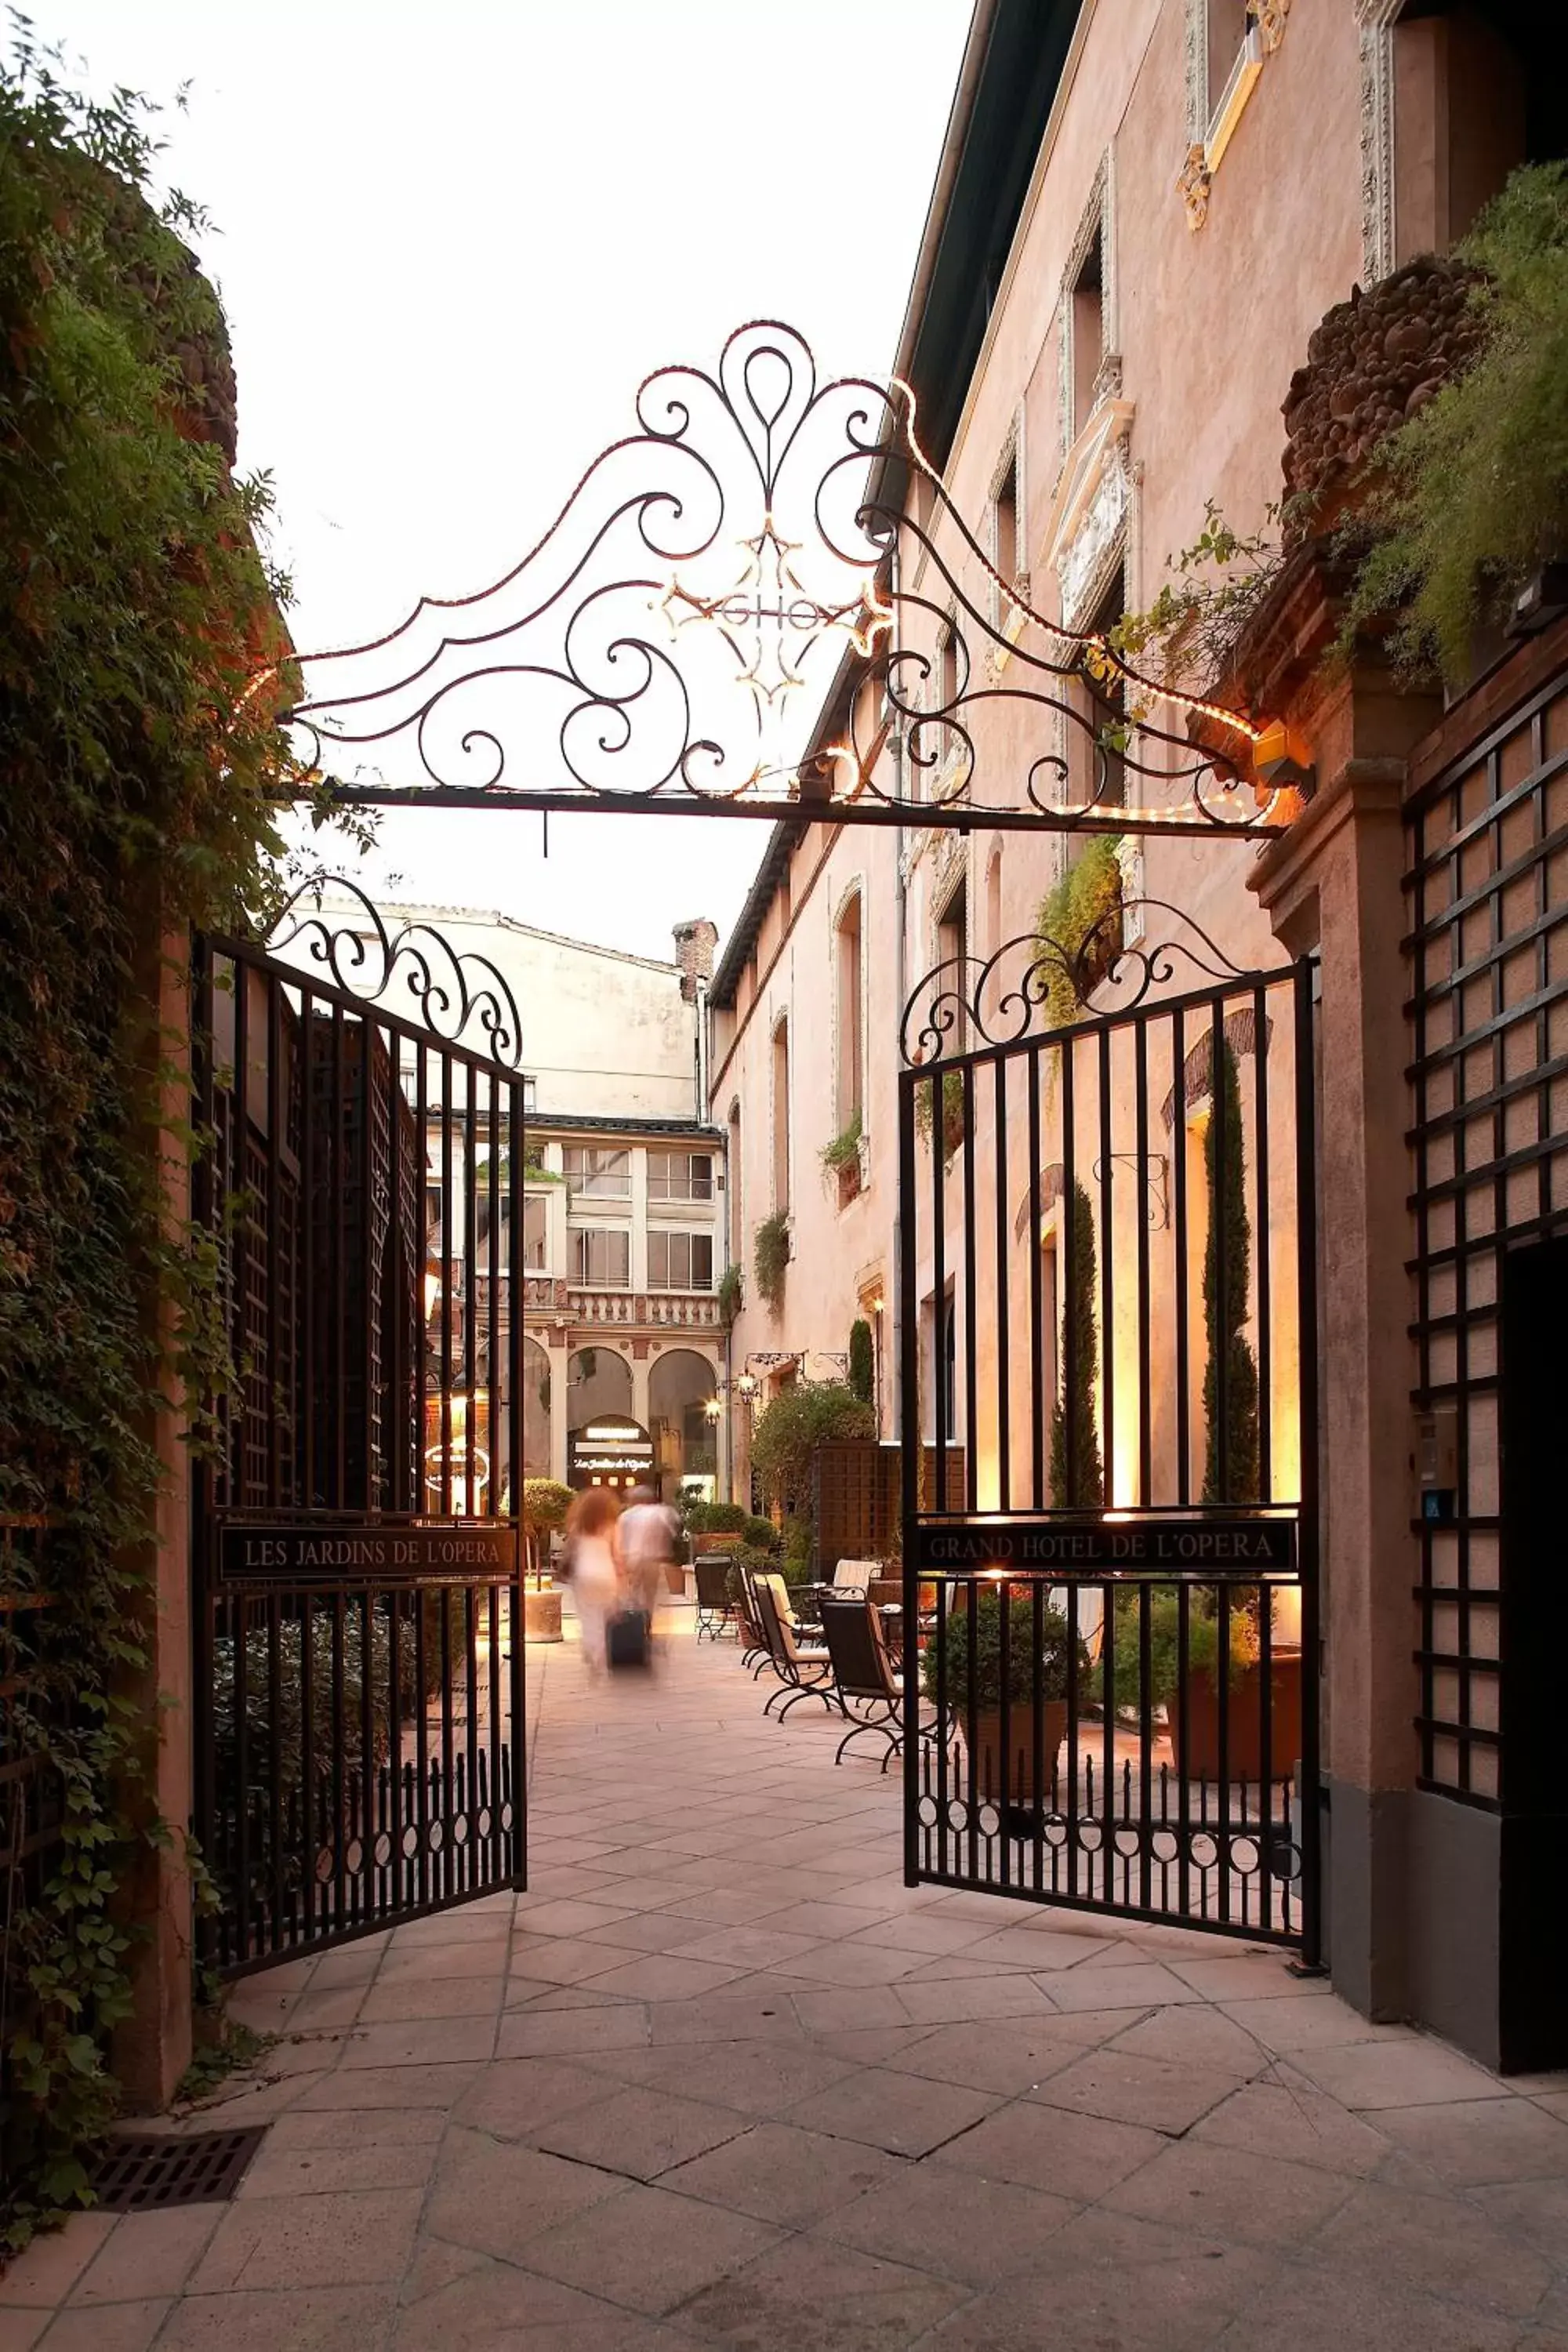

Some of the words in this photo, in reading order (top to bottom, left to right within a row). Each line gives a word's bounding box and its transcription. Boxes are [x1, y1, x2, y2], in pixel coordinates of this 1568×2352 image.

[245, 1540, 287, 1566] LES
[296, 1540, 385, 1566] JARDINS
[394, 1541, 420, 1563] DE
[427, 1541, 499, 1563] L'OPERA
[930, 1536, 1013, 1558] GRAND
[1022, 1536, 1102, 1558] HOTEL
[1111, 1535, 1145, 1557] DE
[1156, 1534, 1273, 1557] L'OPERA
